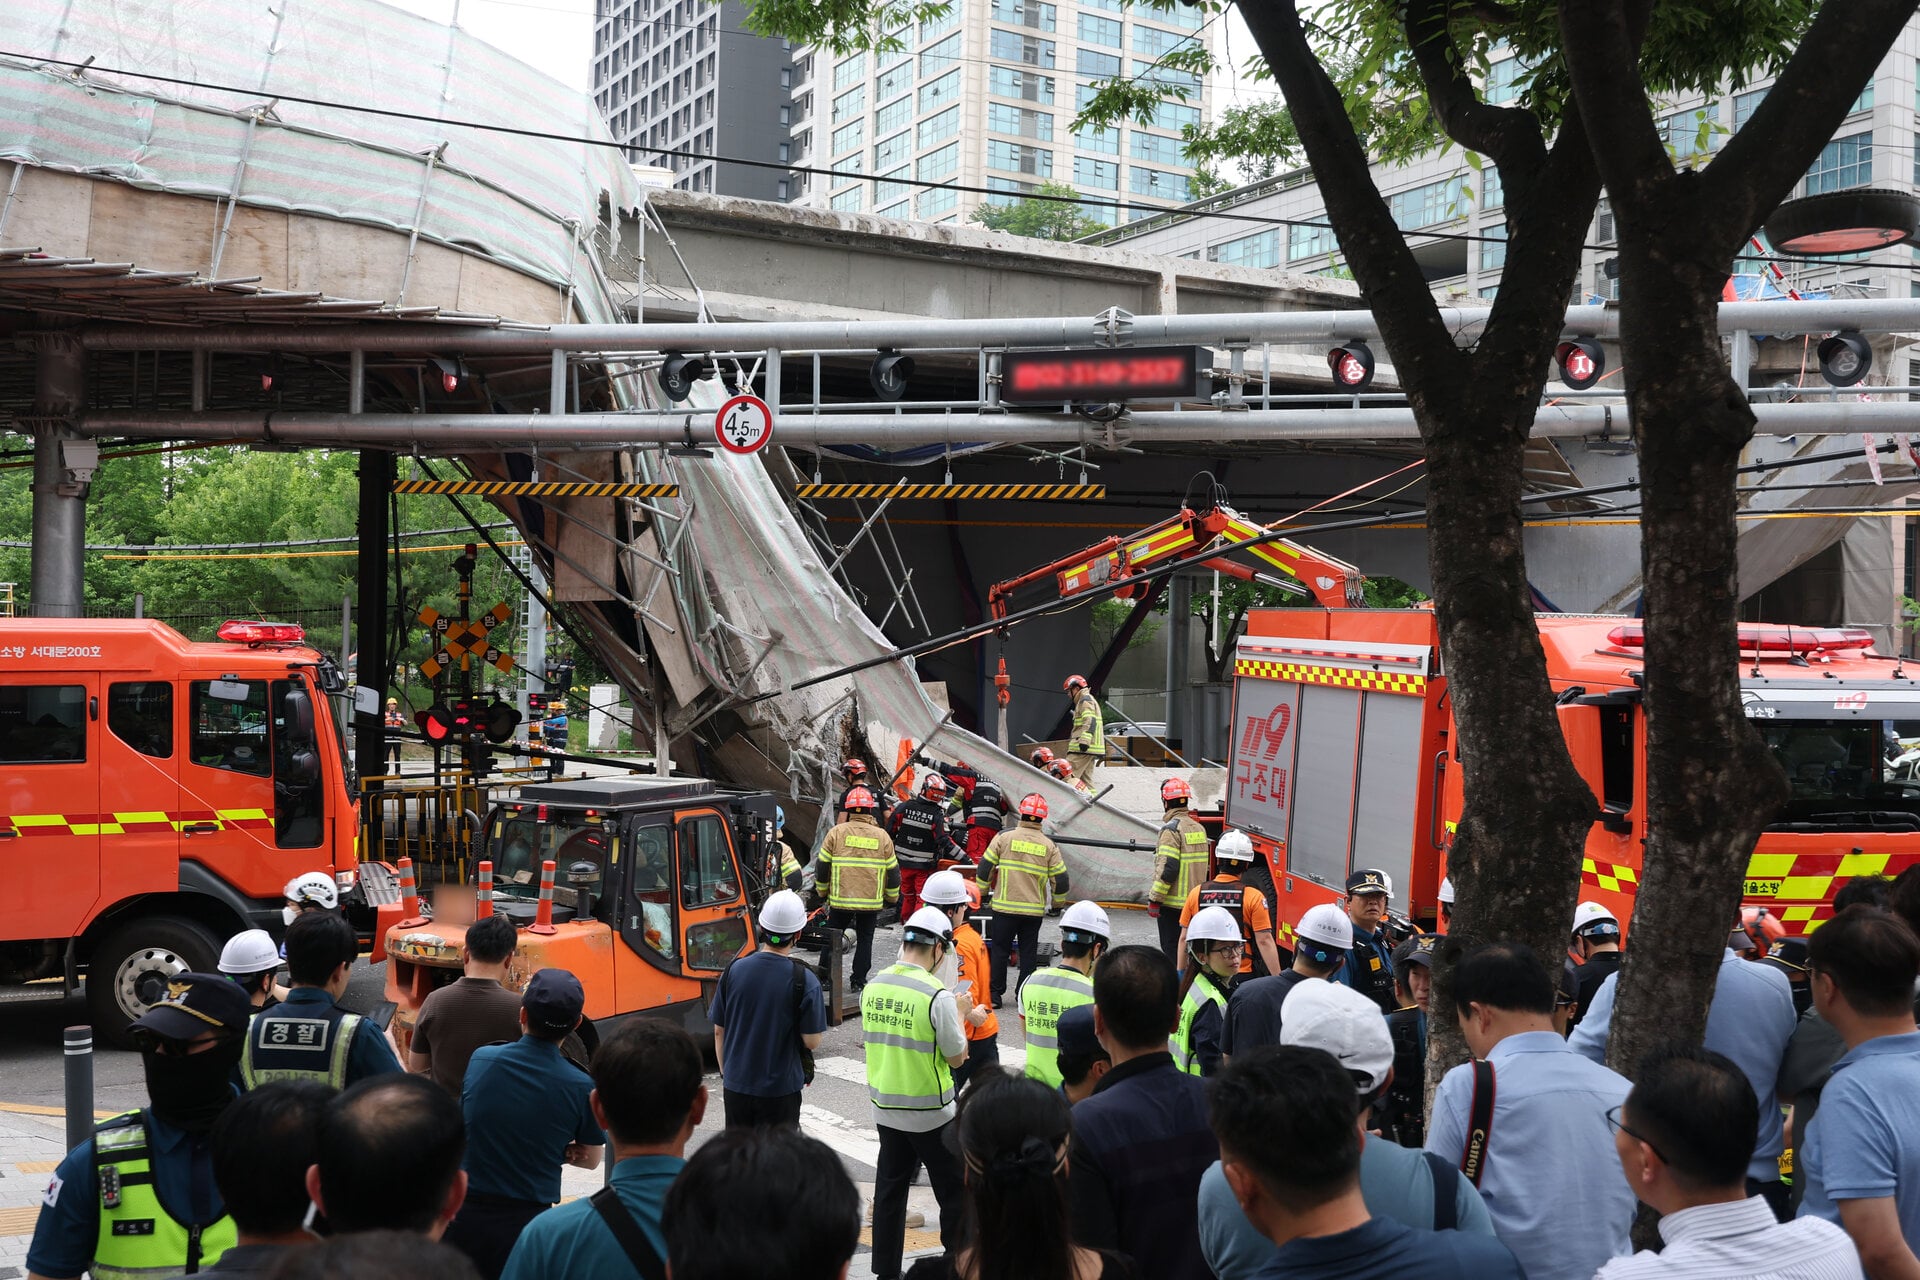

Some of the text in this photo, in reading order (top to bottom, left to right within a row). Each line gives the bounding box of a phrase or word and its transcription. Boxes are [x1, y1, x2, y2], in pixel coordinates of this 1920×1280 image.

[724, 412, 760, 437] 4.5m
[30, 645, 102, 658] 서대문200호
[1835, 691, 1868, 708] 119
[1743, 706, 1776, 719] 울소방
[1238, 703, 1291, 761] 119
[1236, 759, 1287, 810] 구조대
[866, 996, 915, 1017] 서울특별시
[1465, 1128, 1485, 1178] Canon
